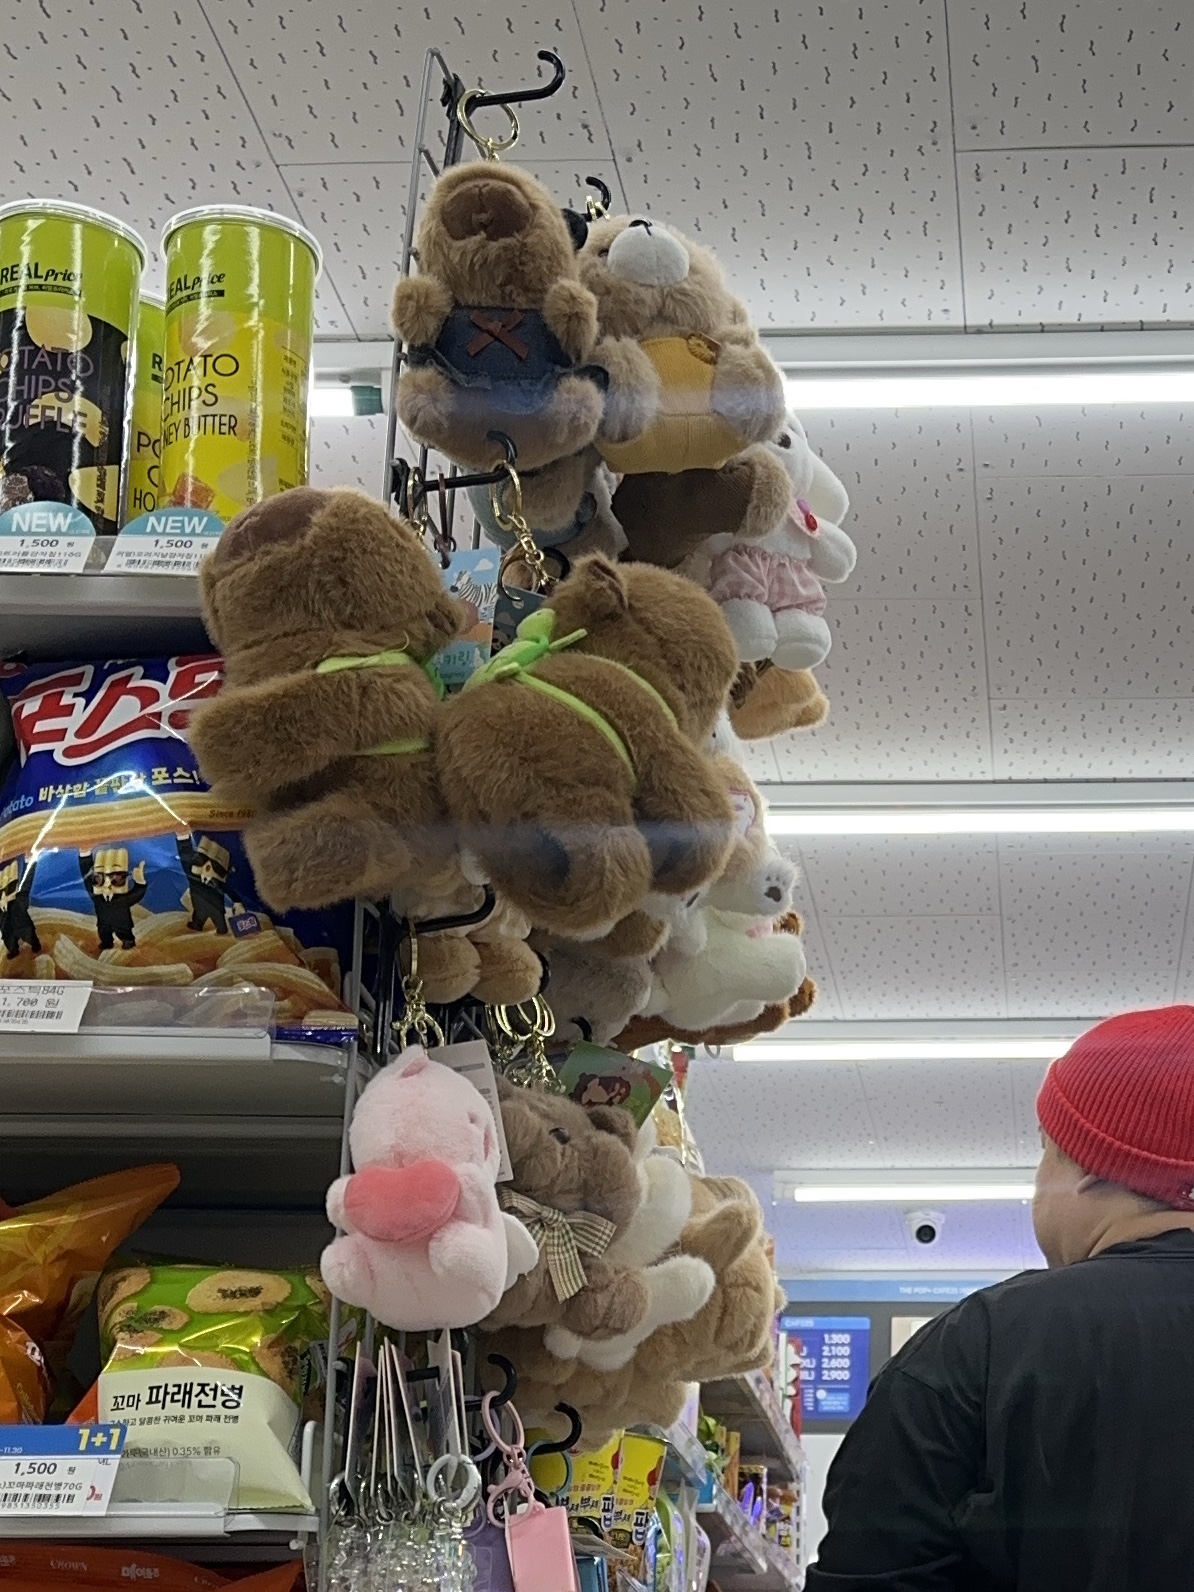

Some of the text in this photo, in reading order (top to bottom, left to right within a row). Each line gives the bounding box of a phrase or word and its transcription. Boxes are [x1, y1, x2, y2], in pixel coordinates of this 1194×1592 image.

[11, 512, 73, 532] NEW
[146, 516, 208, 533] NEW
[19, 539, 59, 548] 1,500
[153, 539, 193, 549] 1,500
[151, 767, 200, 787] 포스!
[2, 997, 38, 1007] 1,700
[110, 1382, 244, 1412] 꼬마 파래전병
[78, 1428, 121, 1451] 1+1
[14, 1462, 57, 1476] 1,500
